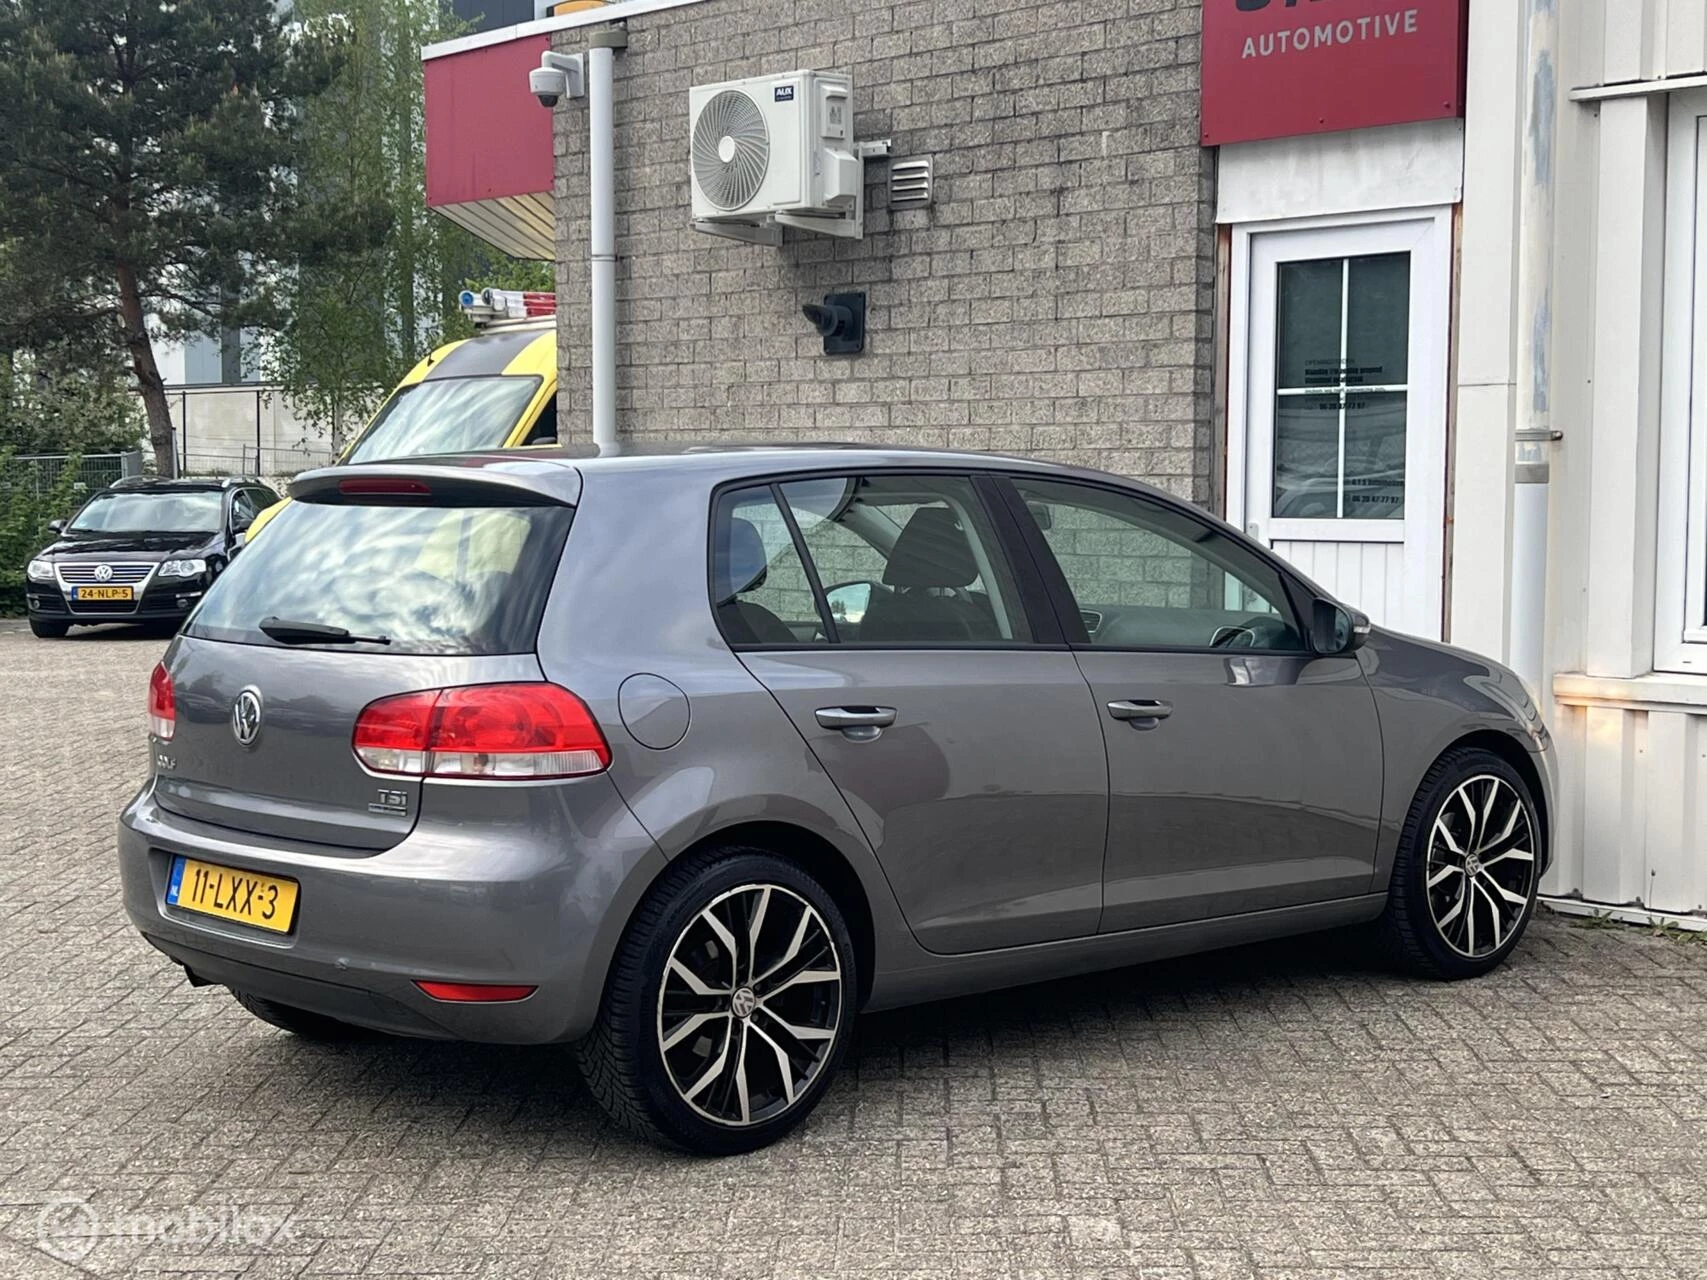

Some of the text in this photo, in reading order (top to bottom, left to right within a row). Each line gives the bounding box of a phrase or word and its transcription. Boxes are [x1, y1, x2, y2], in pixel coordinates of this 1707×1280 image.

[1241, 9, 1418, 59] AUTOMOTIVE
[776, 86, 792, 96] AUX
[80, 589, 129, 599] 24-NLP-5
[192, 868, 279, 920] 11-LXX-3
